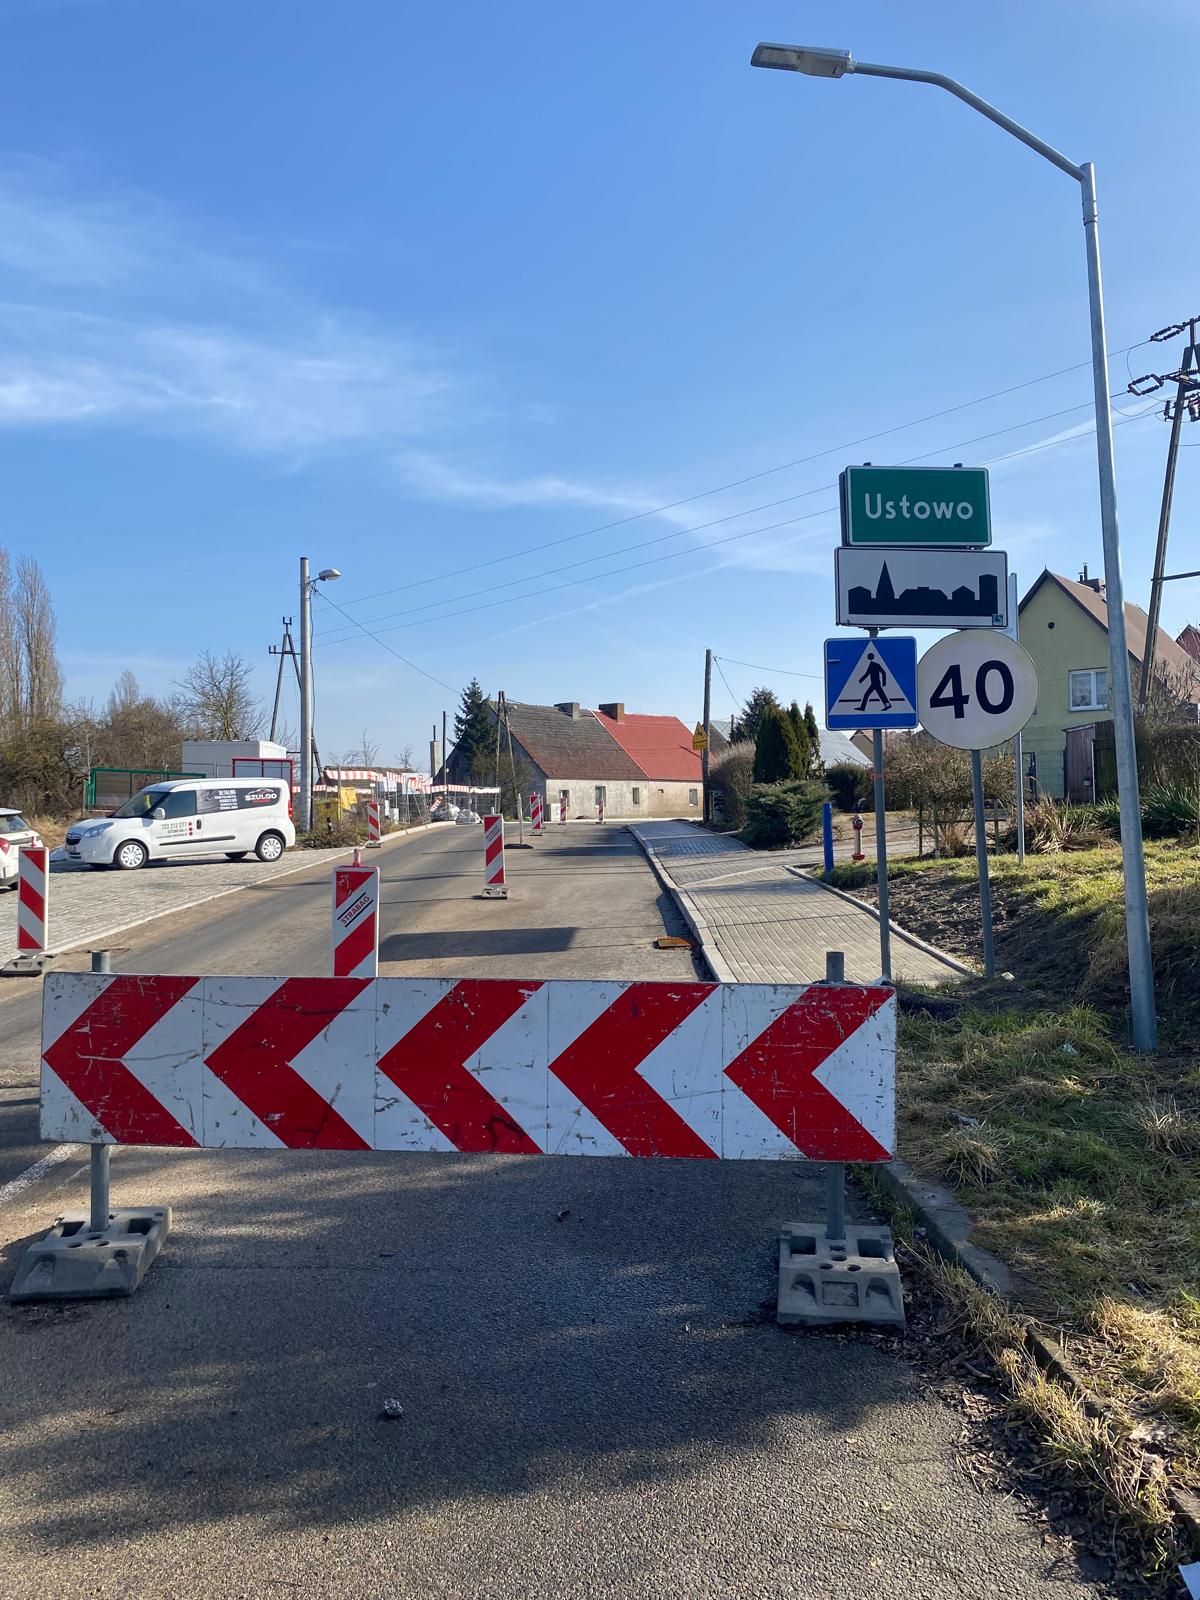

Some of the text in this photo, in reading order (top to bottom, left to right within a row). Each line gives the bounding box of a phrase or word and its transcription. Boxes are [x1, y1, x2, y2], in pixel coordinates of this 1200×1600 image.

[865, 493, 974, 520] Ustowo
[929, 659, 1014, 719] 40
[341, 895, 371, 925] STRABAG
